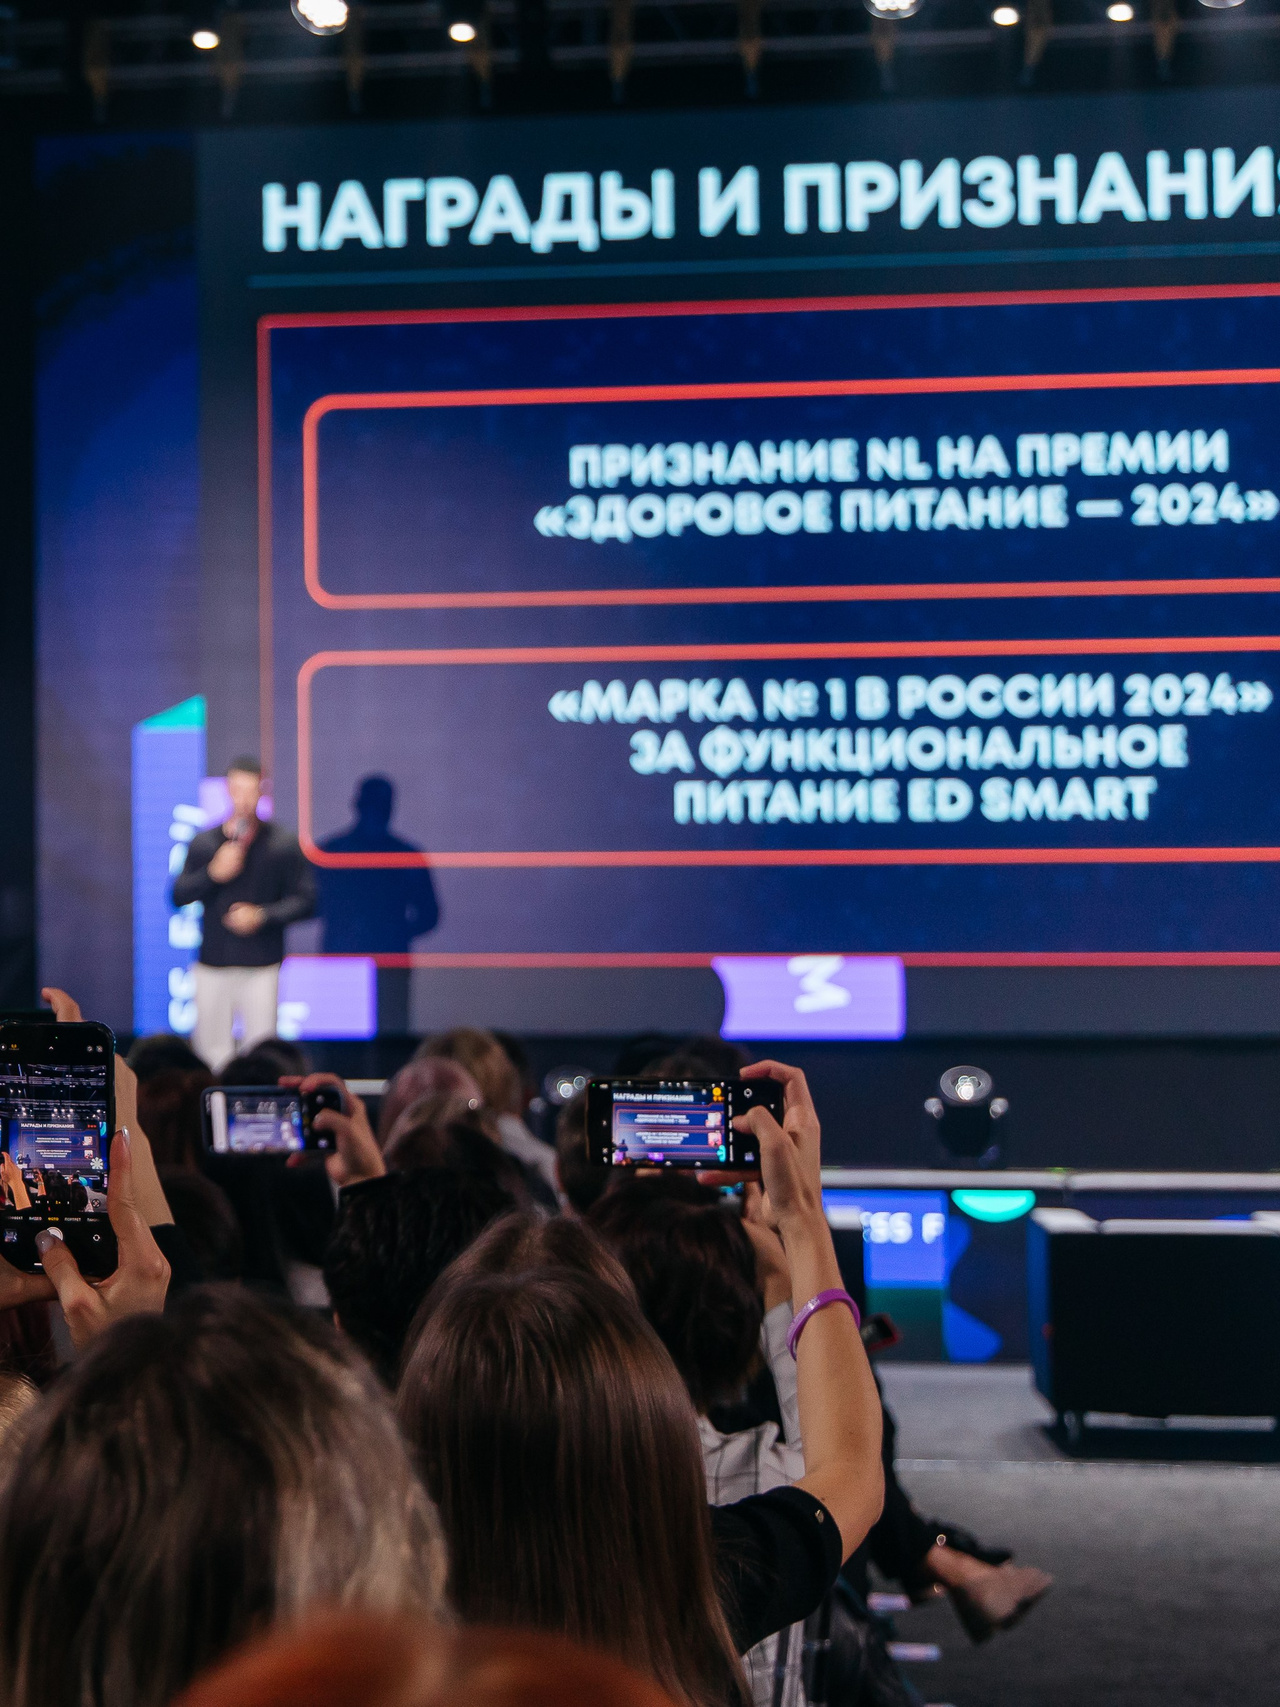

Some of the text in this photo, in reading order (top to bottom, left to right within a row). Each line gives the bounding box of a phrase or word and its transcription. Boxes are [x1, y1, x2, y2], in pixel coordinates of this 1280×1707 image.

[261, 145, 1280, 254] НАГРАДЫ И ПРИЗНАНИ
[569, 428, 1230, 489] ПРИЗНАНИЕ NL НА ПРЕМИИ
[533, 490, 833, 544] «ЗДОРОВОЕ
[840, 484, 1069, 532] ПИТАНИЕ
[1130, 481, 1280, 527] 2024»
[547, 678, 759, 725] «МАРКА
[855, 675, 890, 721] В
[897, 672, 1115, 721] РОССИИ
[1122, 672, 1273, 716] 2024»
[628, 723, 1189, 779] ЗА ФУНКЦИОНАЛЬНОЕ
[674, 775, 1158, 824] ПИТАНИЕ ED SMART
